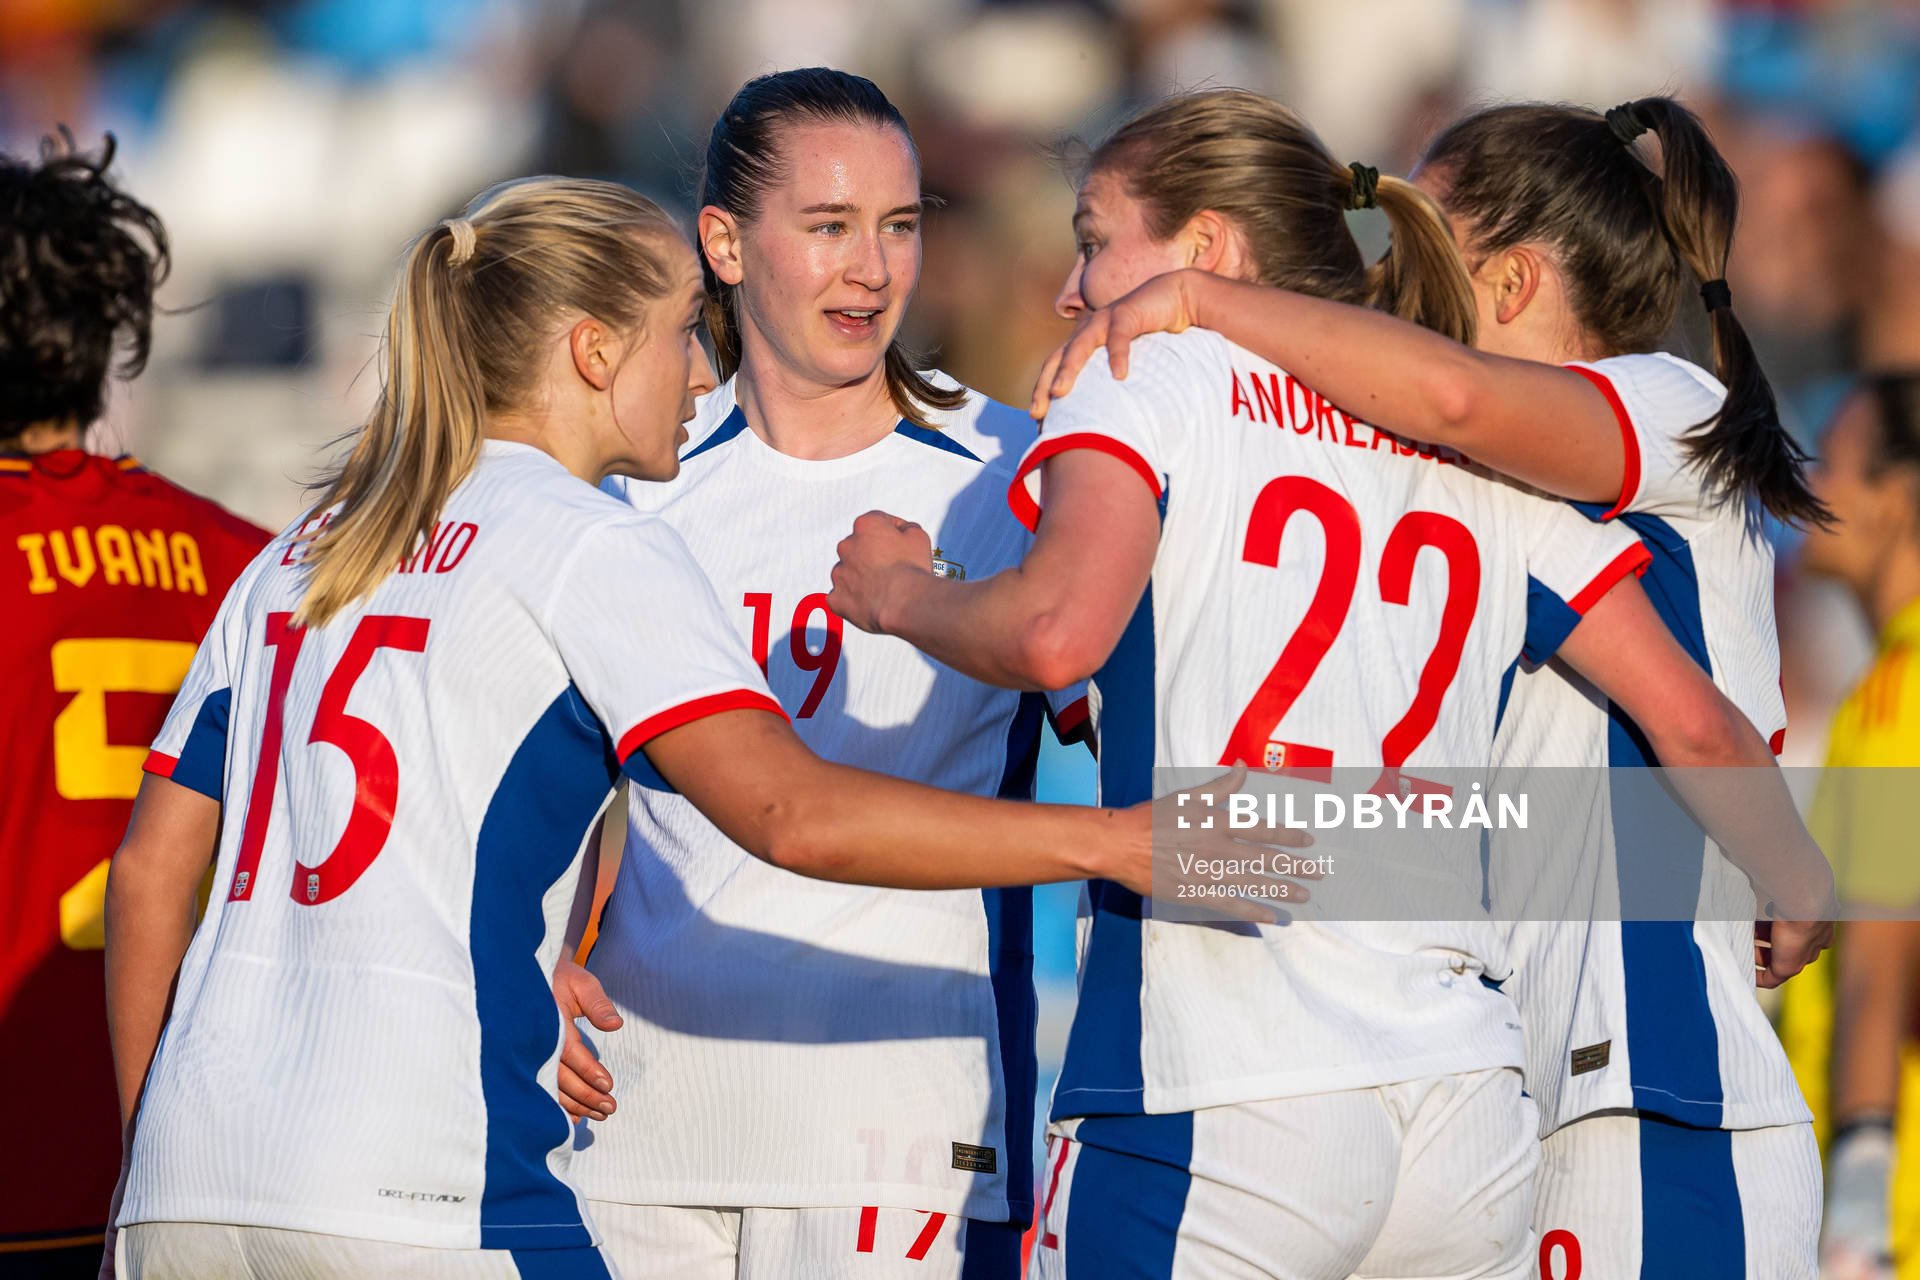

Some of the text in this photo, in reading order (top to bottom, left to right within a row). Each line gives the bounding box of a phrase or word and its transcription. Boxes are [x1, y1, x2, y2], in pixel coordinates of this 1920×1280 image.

[17, 524, 208, 596] IVANA
[743, 592, 844, 719] 19
[1217, 475, 1481, 815] 22
[227, 611, 431, 906] 15
